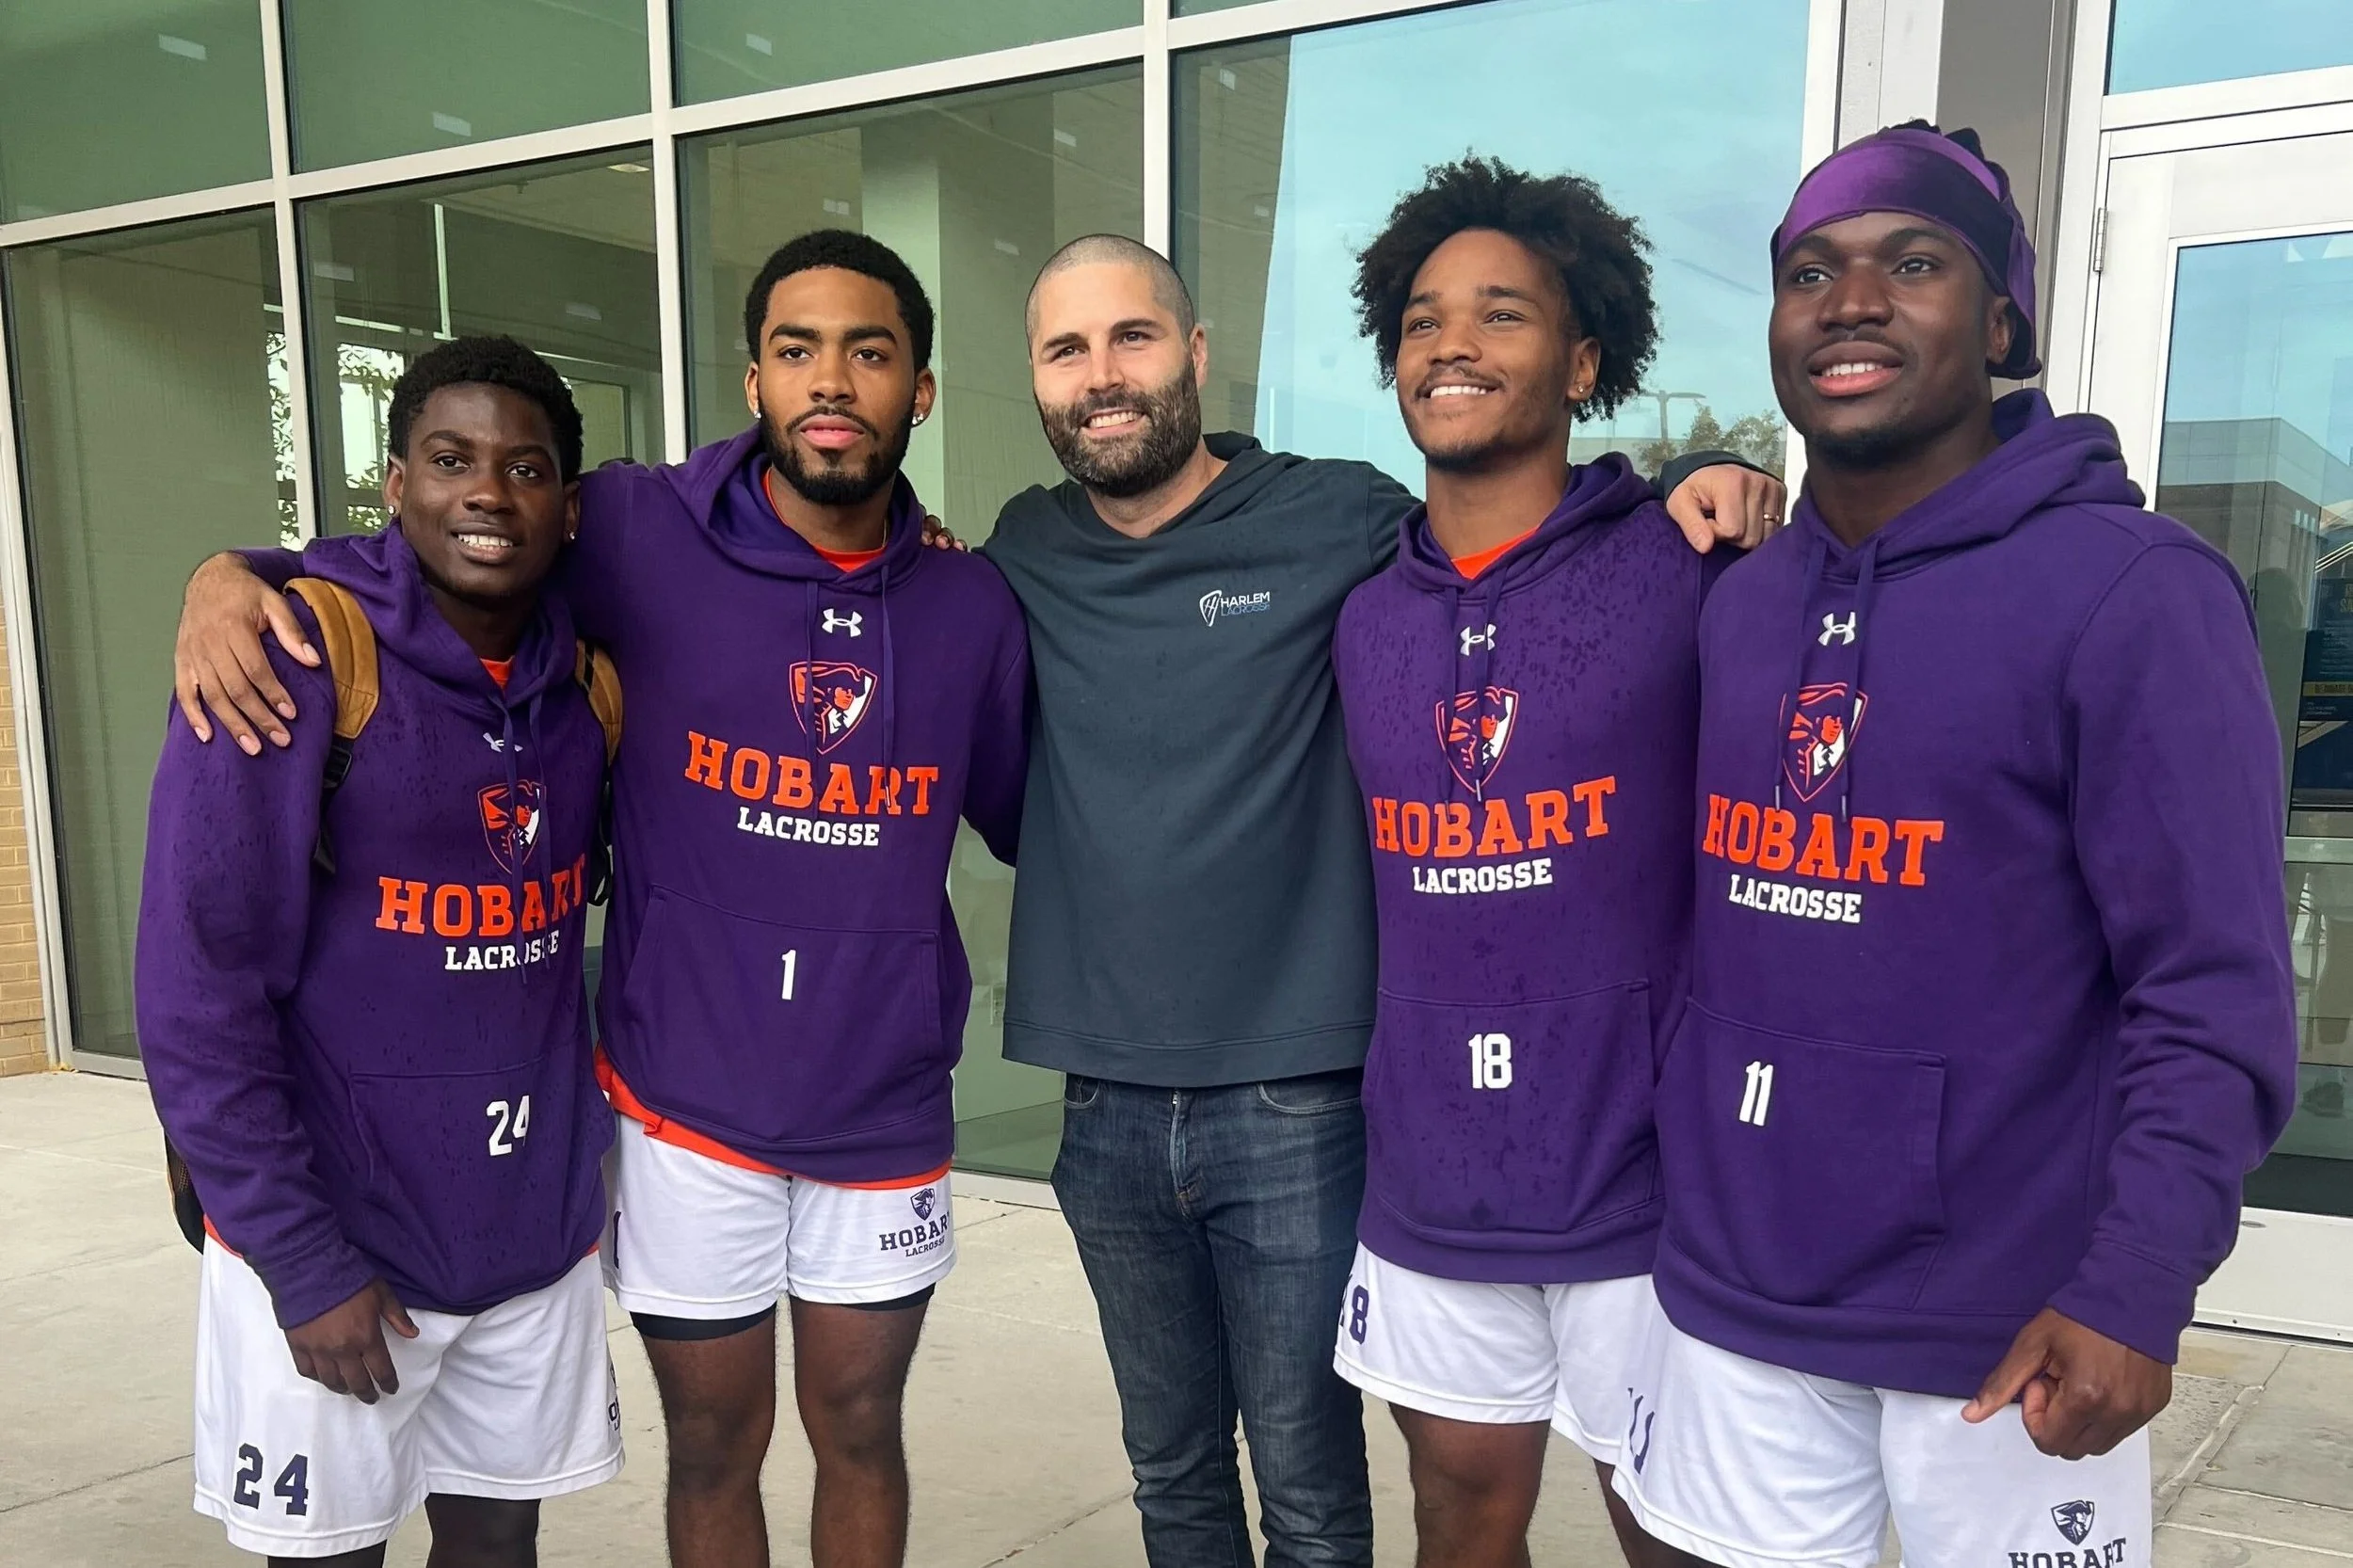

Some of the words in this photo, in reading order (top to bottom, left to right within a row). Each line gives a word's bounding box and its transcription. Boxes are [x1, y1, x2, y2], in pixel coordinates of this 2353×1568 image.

[1221, 591, 1271, 608] HARLEM
[684, 730, 939, 816] HOBART
[737, 807, 880, 847] LACROSSE
[1372, 776, 1617, 858] HOBART
[1703, 793, 1945, 887] HOBART
[376, 852, 585, 937] HOBART
[1412, 857, 1553, 895] LACROSSE
[1729, 873, 1863, 924] LACROSSE
[781, 949, 797, 1000] 1
[1468, 1032, 1513, 1090] 18
[1738, 1060, 1775, 1128] 11
[486, 1095, 530, 1157] 24
[879, 1210, 950, 1251] HOBAR
[233, 1442, 310, 1517] 24
